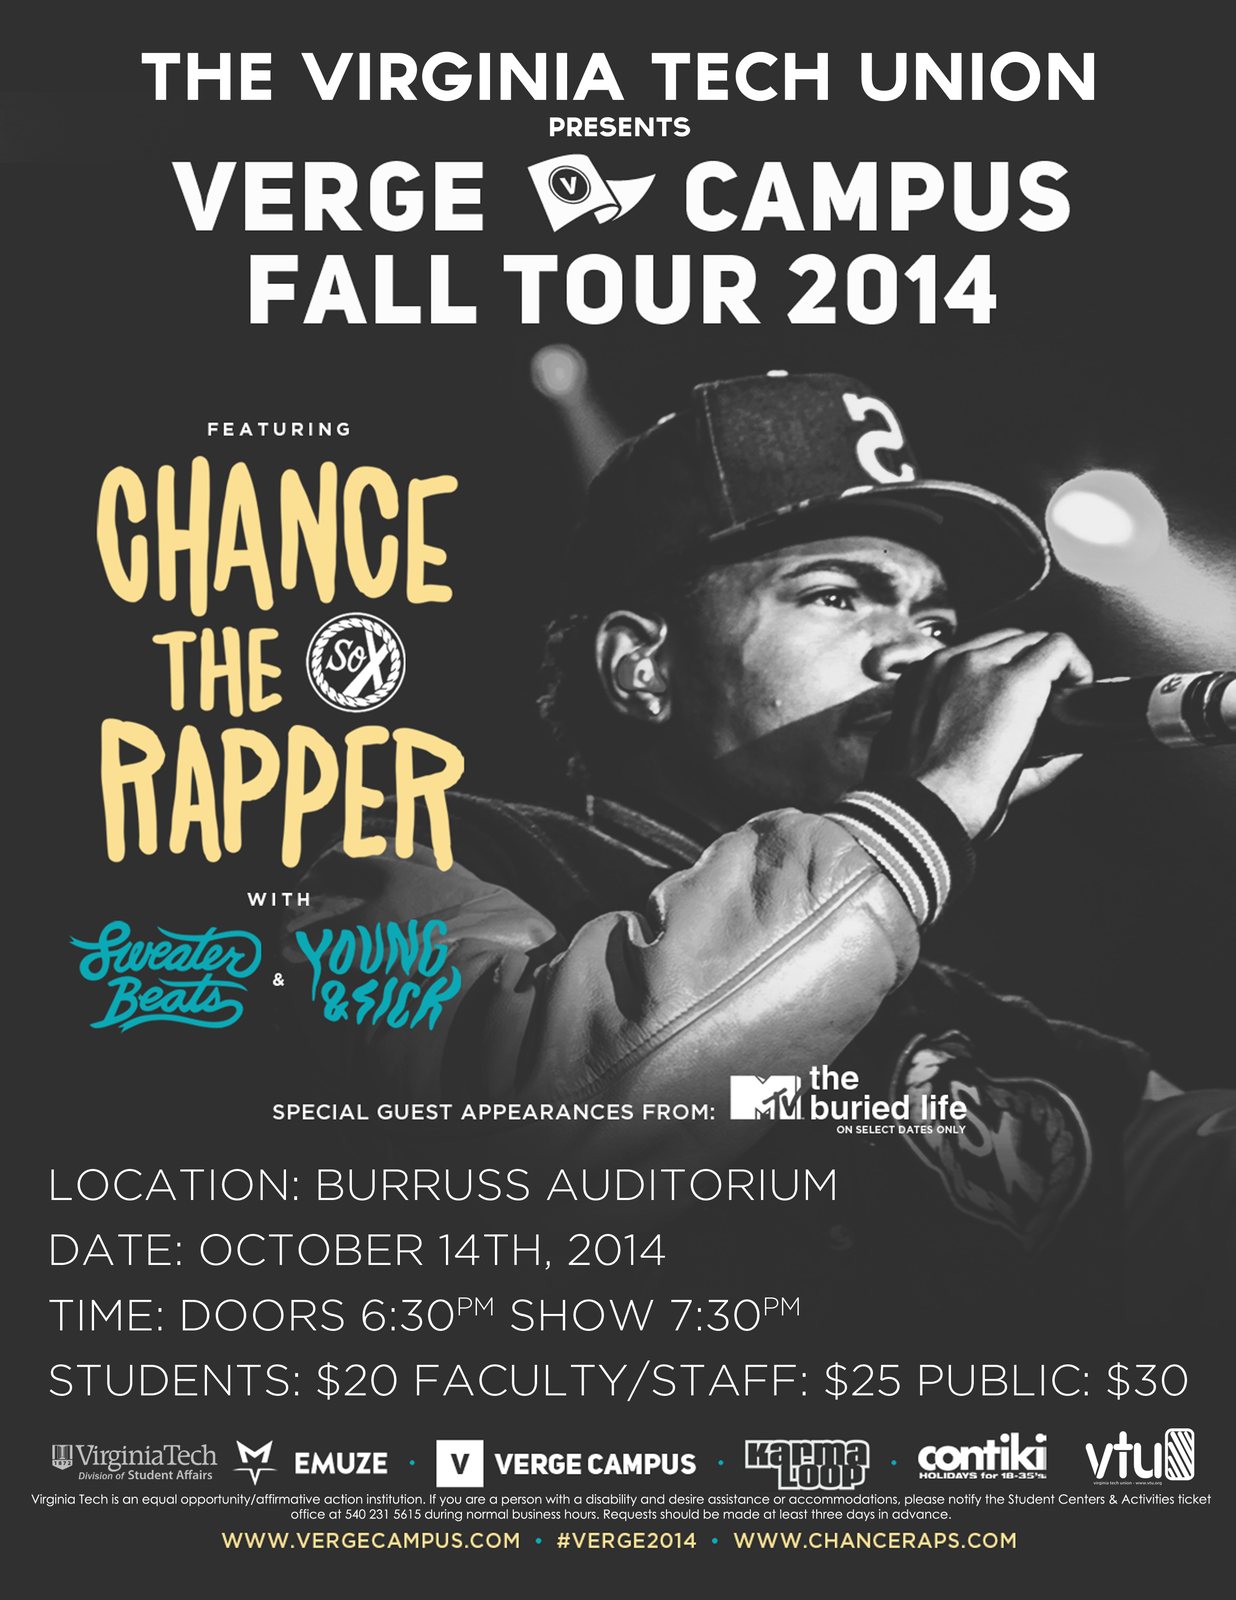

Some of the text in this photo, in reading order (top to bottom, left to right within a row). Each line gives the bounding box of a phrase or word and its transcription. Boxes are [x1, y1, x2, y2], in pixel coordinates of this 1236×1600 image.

[141, 51, 1094, 102] THE VIRGINIA TECH UNION
[549, 116, 690, 137] PRESENTS
[172, 160, 1070, 232] VERGE CAMPUS
[559, 176, 577, 195] V
[250, 254, 996, 325] FALL TOUR 2014
[207, 422, 350, 436] FEATURING
[97, 456, 457, 616] CHANCE
[153, 627, 281, 716] THE
[102, 719, 464, 871] RAPPER
[247, 893, 310, 906] WITH
[70, 920, 262, 981] Sweater
[296, 919, 448, 1001] YOUNG
[272, 973, 285, 986] &
[90, 973, 247, 1032] Beats
[810, 1065, 859, 1090] the
[730, 1074, 802, 1120] MTV
[811, 1095, 967, 1120] buried life
[273, 1105, 715, 1120] SPECIAL GUEST APPEARANCES FROM:
[836, 1125, 966, 1134] ON SELECT DATES ONLY
[50, 1169, 836, 1201] LOCATION: BURRUSS AUDITORIUM
[50, 1234, 666, 1271] DATE: OCTOBER 14TH, 2014
[49, 1297, 800, 1331] TIME: DOORS 6:30PM SHOW 7:30PM
[49, 1360, 1188, 1401] STUDENTS: $20 FACULTY/STAFF: $25 PUBLIC: $30
[294, 1452, 388, 1475] EMUZE
[450, 1453, 470, 1475] V
[494, 1453, 697, 1475] VERGE CAMPUS
[917, 1432, 1048, 1471] contiki
[1085, 1430, 1163, 1480] vtu
[78, 1469, 213, 1480] Division of Student Affairs
[31, 1494, 1212, 1507] Virginia Tech is an equal opportunity/affirmative action institution. If you are a person with a disability and desire assistance or accommodations, please notify the Student Centers & Activities ticket
[290, 1509, 952, 1522] office at 540 231 5615 during normal business hours. Requests should be made at least three days in advance.
[221, 1532, 1017, 1549] WWW.VERGECAMPUS.COM #VERGE2014 WWW.CHANCERAPS.COM
